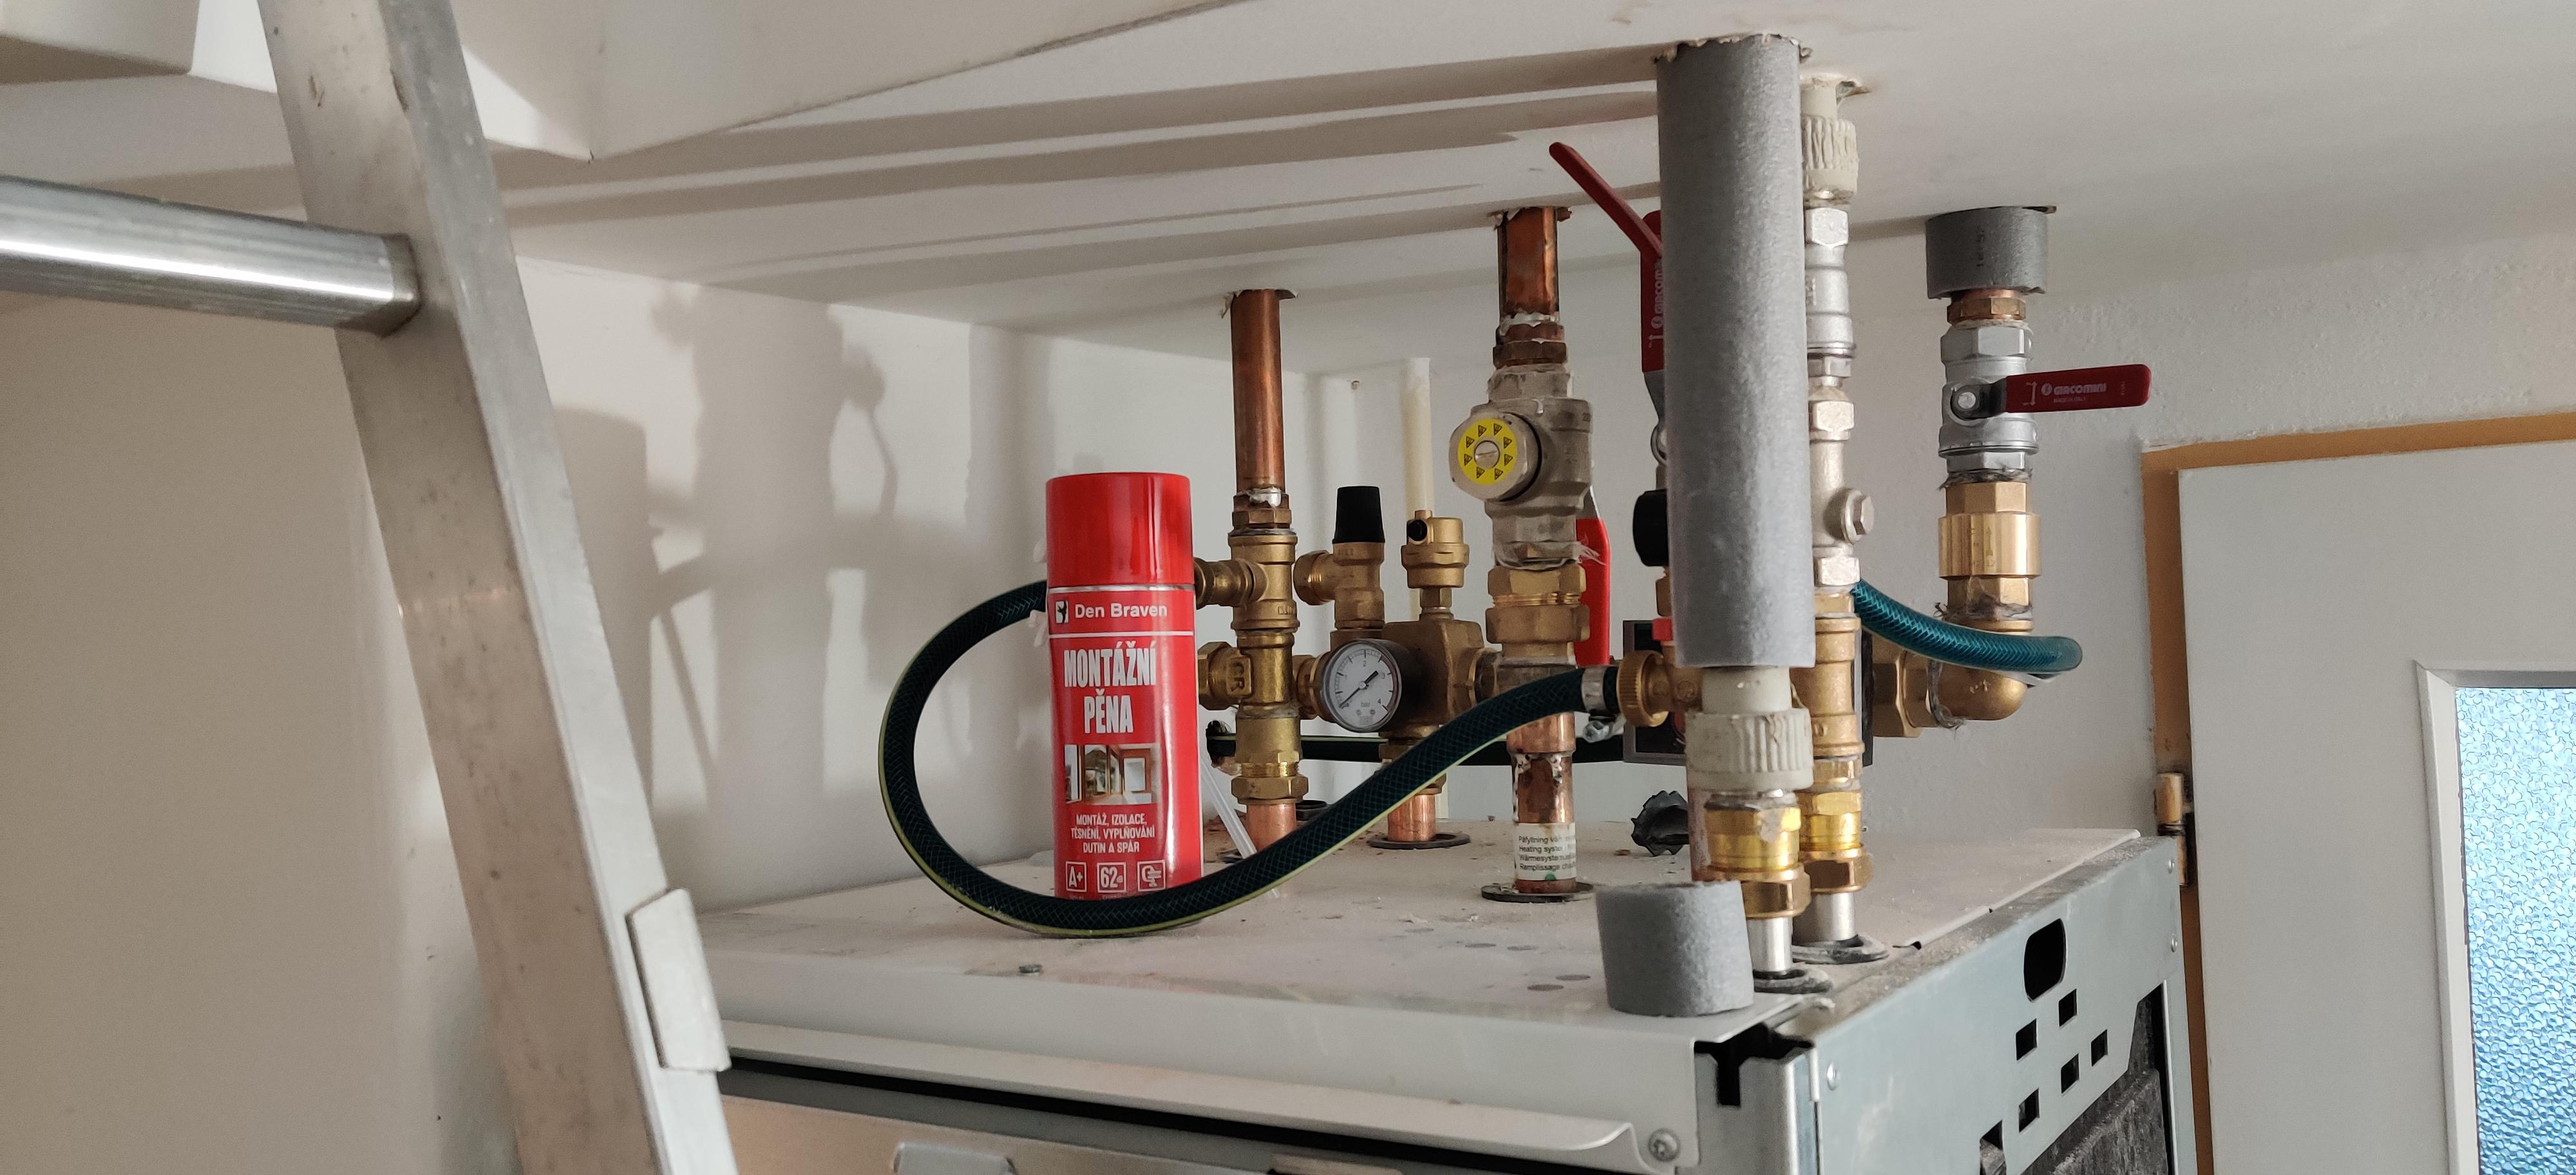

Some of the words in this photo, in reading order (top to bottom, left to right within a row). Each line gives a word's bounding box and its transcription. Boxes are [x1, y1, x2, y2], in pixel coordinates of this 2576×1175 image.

[1075, 604, 1105, 618] Den
[1110, 603, 1168, 618] Braven
[1064, 640, 1157, 688] MONTÁŽNÍ
[1084, 689, 1134, 734] PĚNA
[1076, 812, 1110, 826] MONTÁŽ,
[1112, 813, 1147, 826] IZOLACE,
[1083, 842, 1106, 854] DUTIN
[1108, 842, 1115, 853] A
[1117, 839, 1140, 853] SPÁR
[1519, 845, 1542, 854] Heating
[1068, 866, 1083, 888] A+
